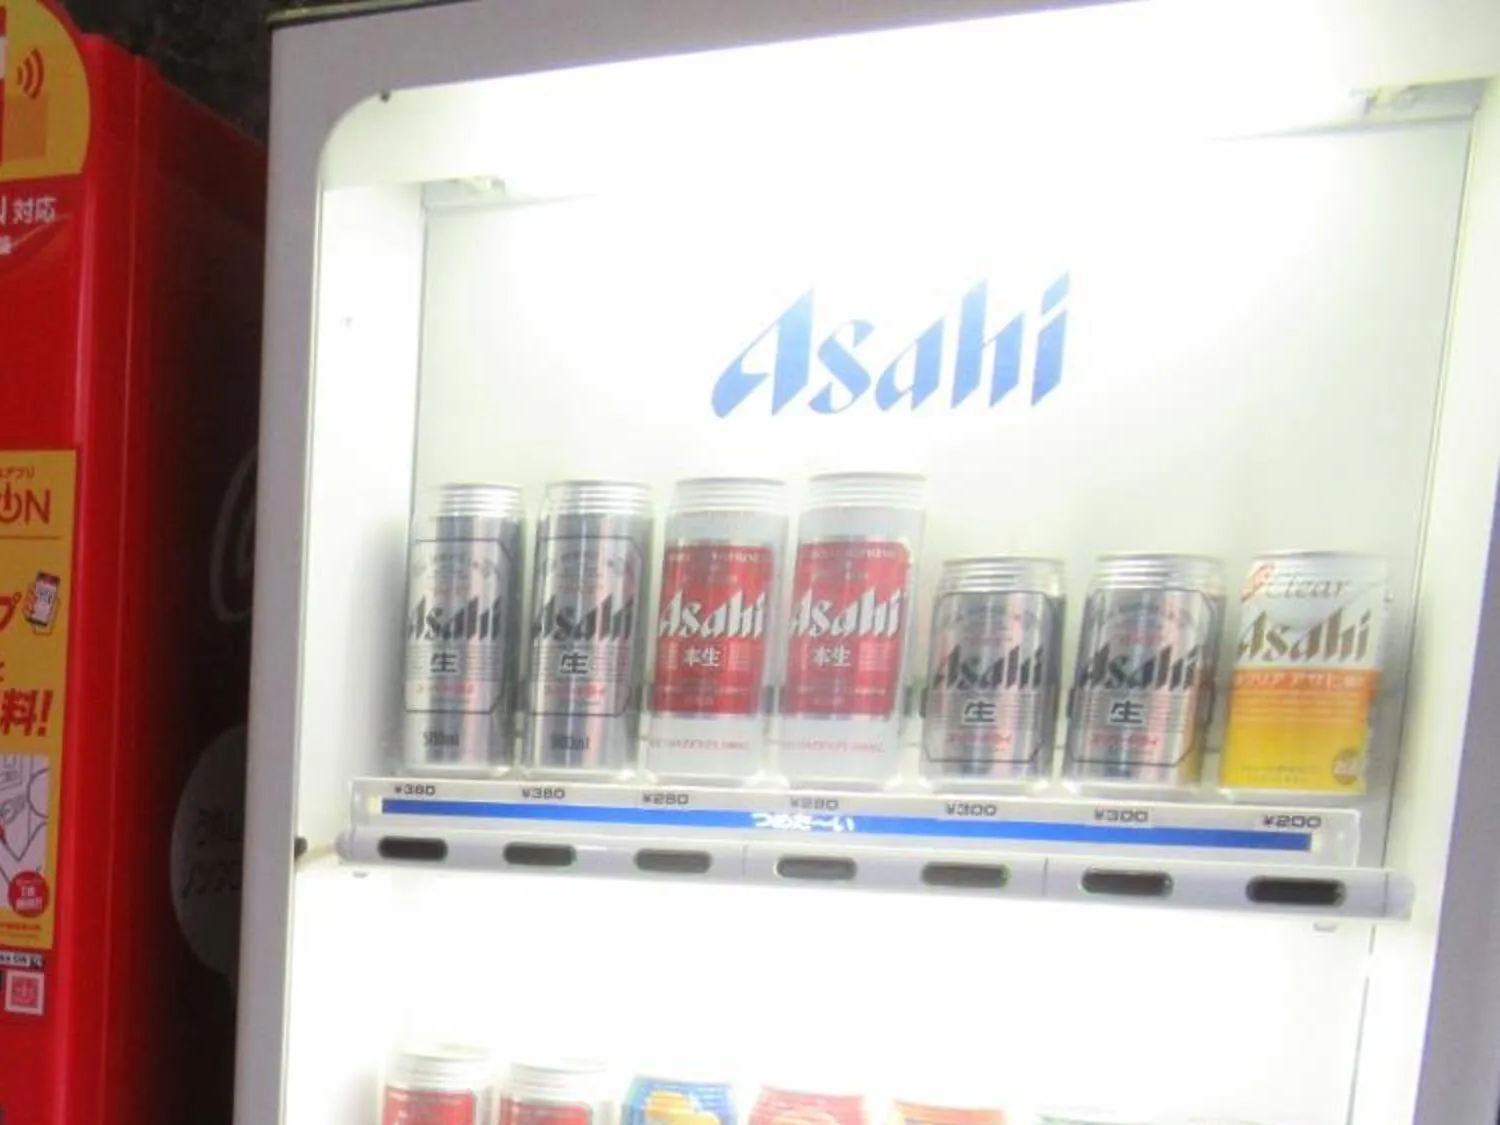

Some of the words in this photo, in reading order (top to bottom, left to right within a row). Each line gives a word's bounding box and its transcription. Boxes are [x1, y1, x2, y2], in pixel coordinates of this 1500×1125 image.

[11, 196, 58, 226] 対応
[710, 269, 1071, 420] Asahi
[408, 594, 503, 642] Asahi
[531, 593, 634, 643] Asahi
[661, 590, 767, 641] Asahi
[788, 586, 907, 640] Asahi
[1236, 609, 1374, 664] Asahi
[430, 650, 459, 676] 生
[558, 651, 590, 677] 生
[681, 647, 722, 670] 本生
[810, 644, 853, 670] 本生
[931, 644, 1045, 692] Asahi
[1078, 643, 1200, 692] Asahi
[962, 699, 997, 725] 生
[1109, 700, 1145, 725] 生
[521, 786, 565, 801] ¥380
[642, 791, 690, 806] ¥280
[945, 801, 998, 817] ¥300
[1094, 808, 1150, 824] ¥300
[1263, 813, 1323, 830] ¥200
